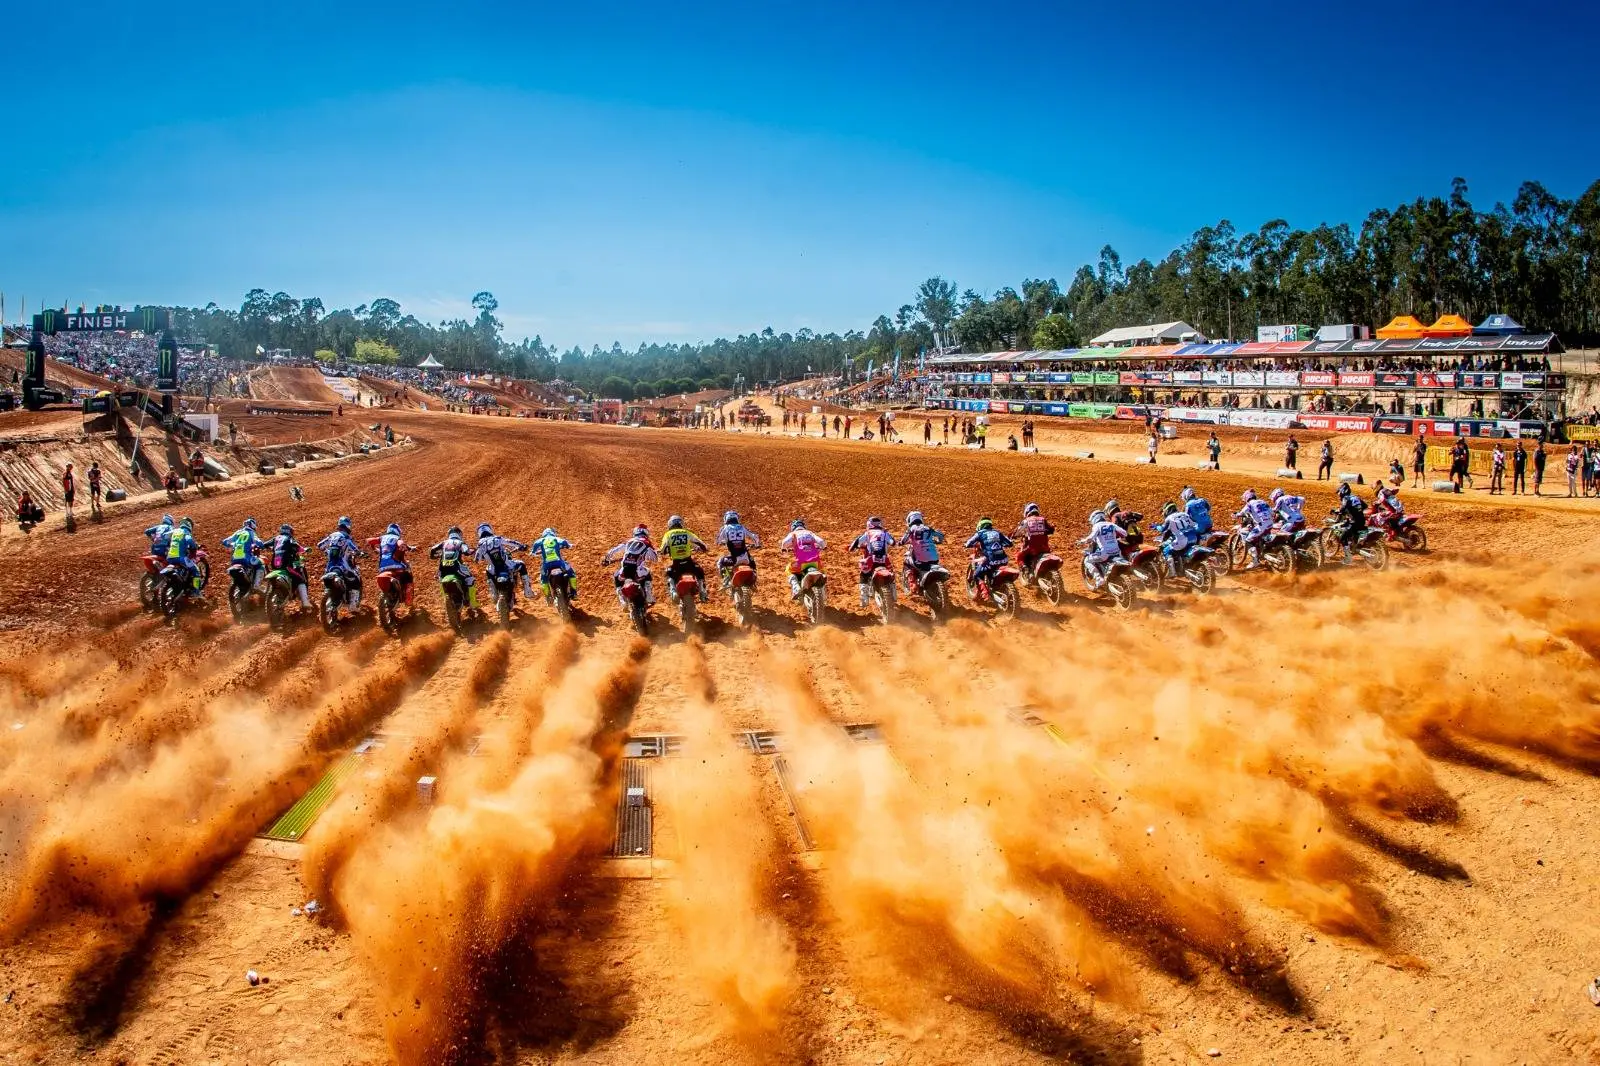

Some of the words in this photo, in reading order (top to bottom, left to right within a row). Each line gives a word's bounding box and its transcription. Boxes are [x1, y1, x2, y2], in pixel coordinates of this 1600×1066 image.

[68, 316, 126, 328] FINISH
[1305, 375, 1332, 383] DUCATI
[1341, 375, 1371, 384] DUCATI
[1301, 419, 1329, 428] DUCATI
[1336, 421, 1368, 430] DUCATI
[1100, 525, 1114, 536] 64
[671, 533, 688, 546] 253
